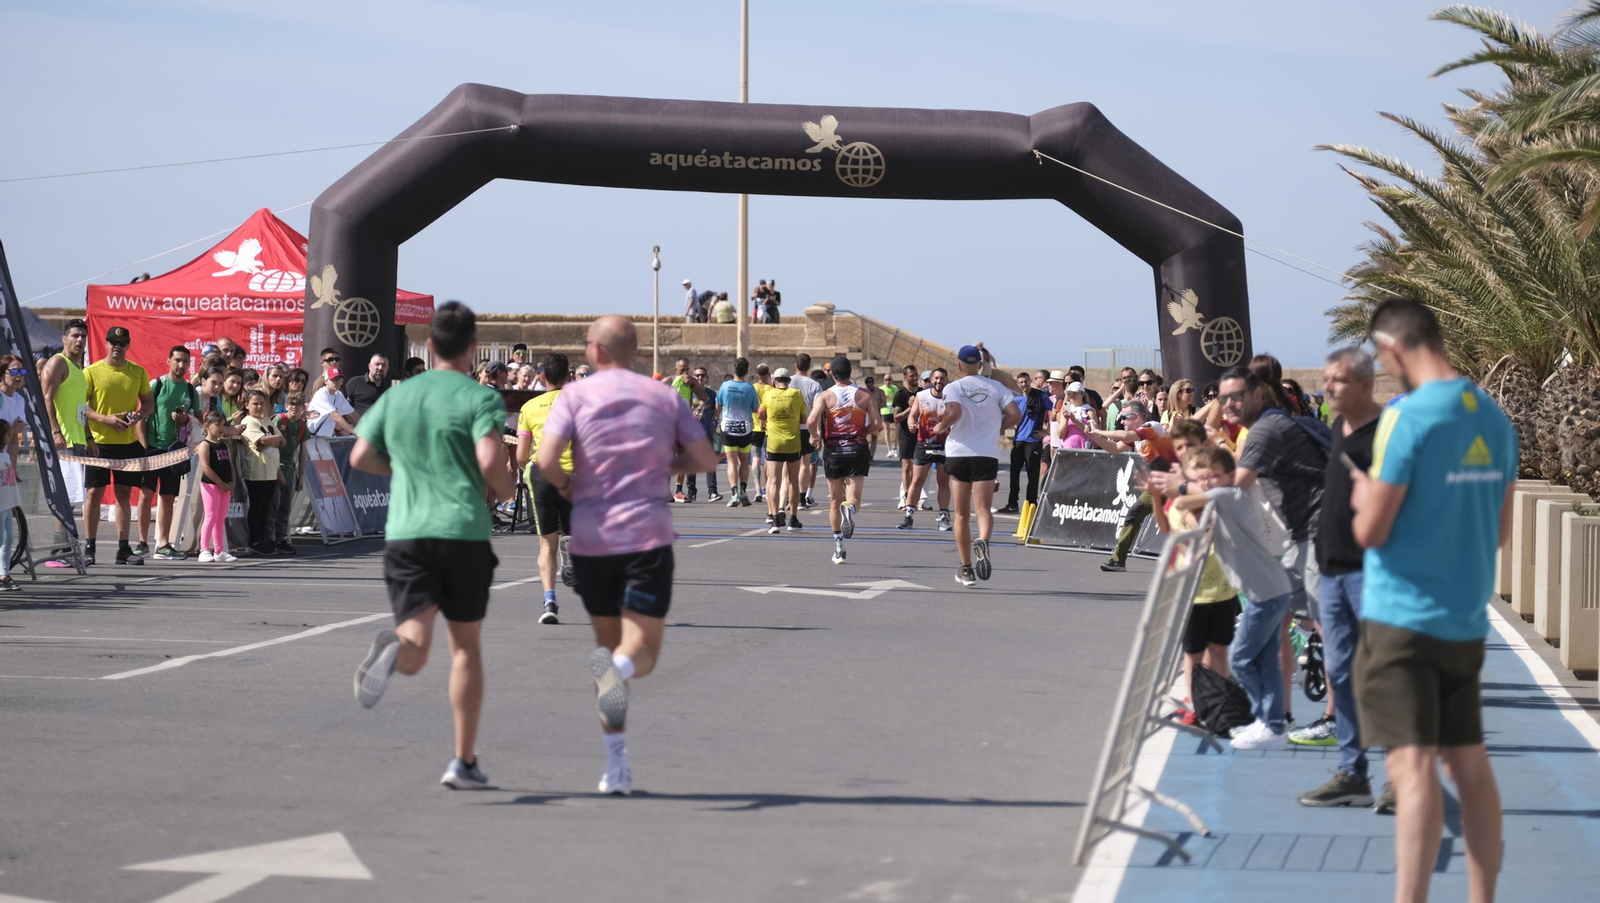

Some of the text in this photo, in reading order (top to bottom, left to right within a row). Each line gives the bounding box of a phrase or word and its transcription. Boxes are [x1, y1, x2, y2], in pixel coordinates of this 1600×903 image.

[649, 149, 822, 171] aquéatacamos
[353, 487, 392, 515] aquéatac
[1052, 499, 1120, 525] aquéatacamos
